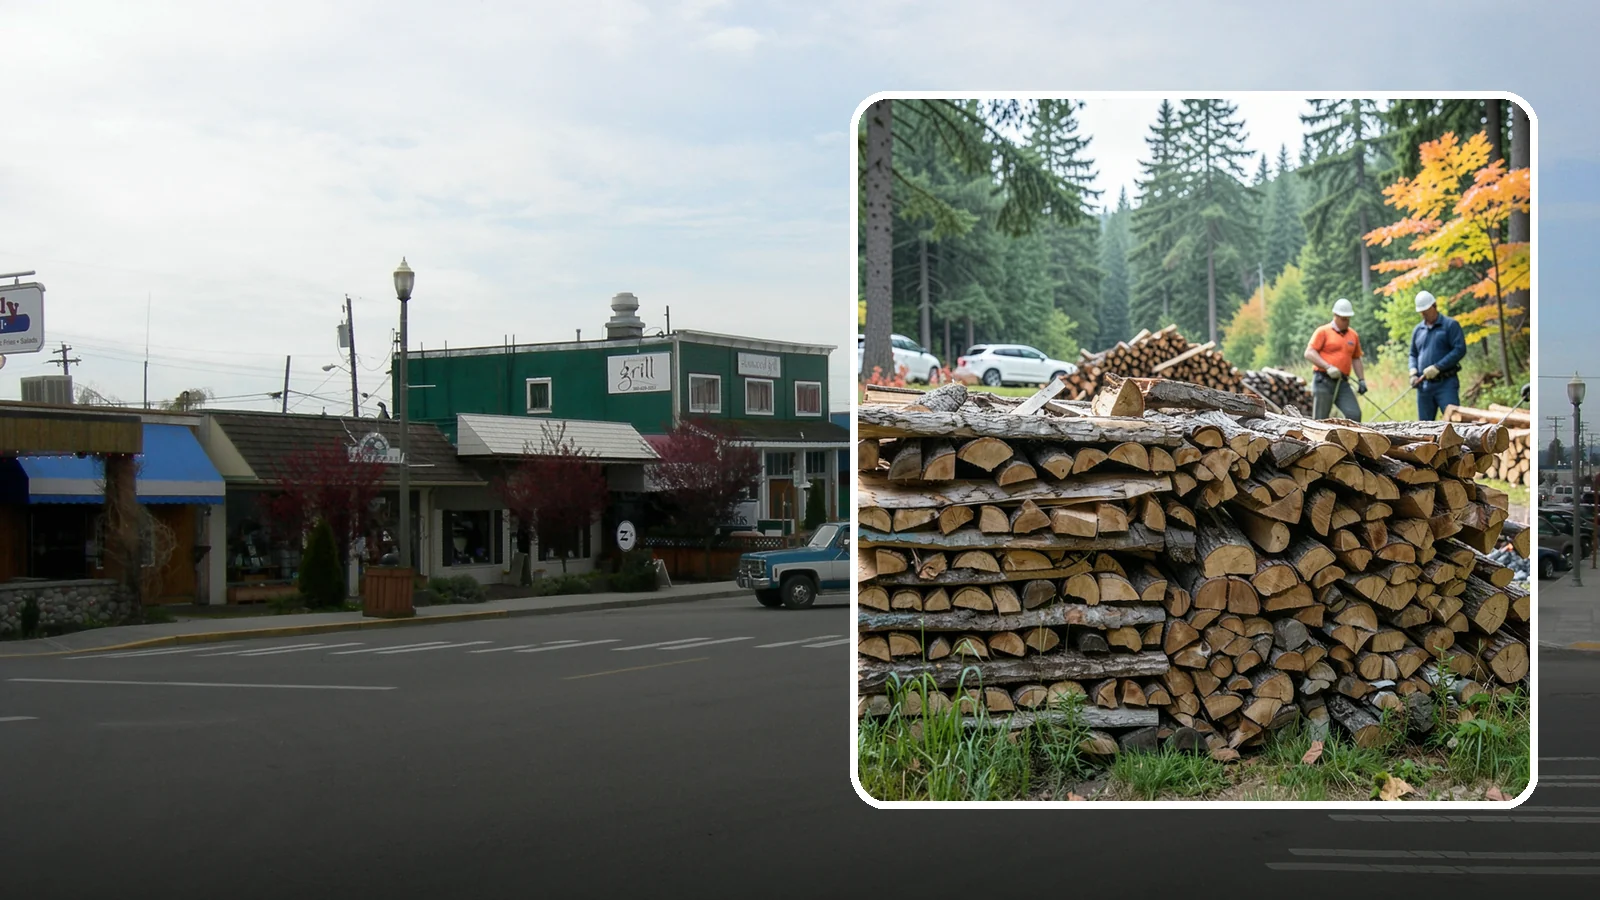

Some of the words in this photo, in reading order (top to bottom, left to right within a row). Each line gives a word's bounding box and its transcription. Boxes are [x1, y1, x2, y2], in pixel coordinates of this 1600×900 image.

[3, 338, 16, 346] Fries
[20, 336, 38, 345] Salads
[617, 356, 654, 391] grill
